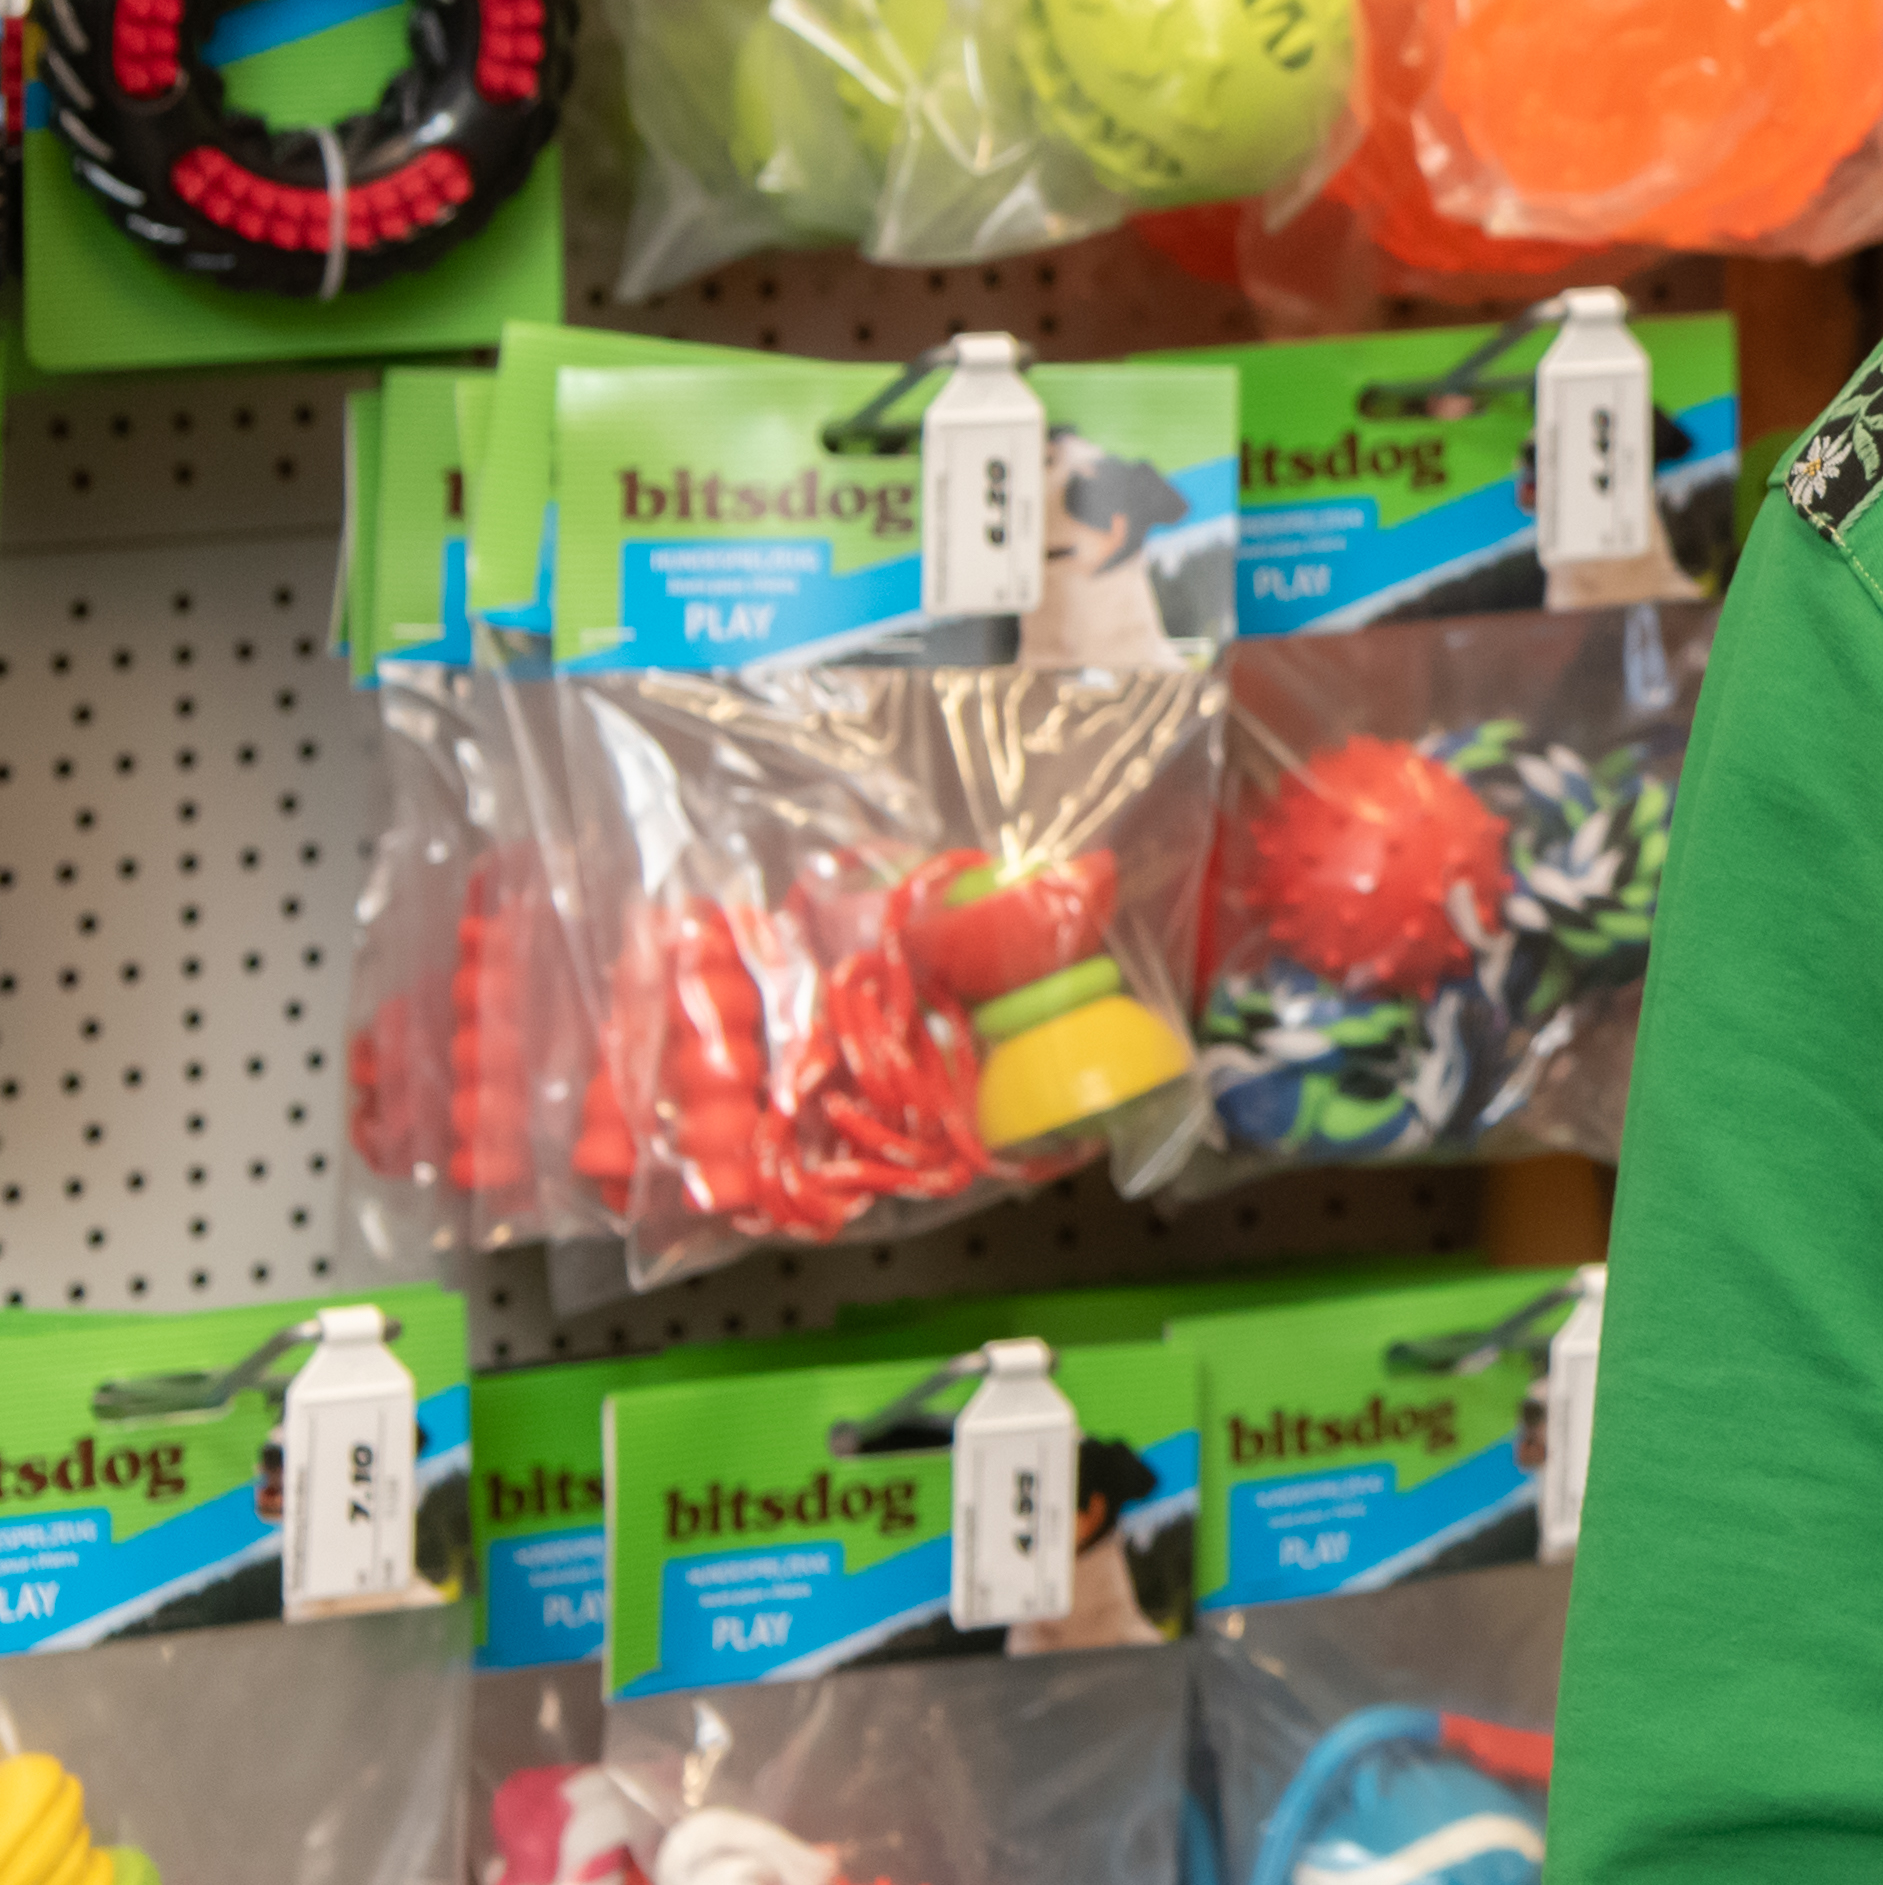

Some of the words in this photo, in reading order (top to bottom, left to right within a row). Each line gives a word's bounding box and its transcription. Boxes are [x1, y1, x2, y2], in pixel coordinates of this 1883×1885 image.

[1240, 429, 1448, 492] itsdog
[620, 468, 915, 539] bitsdog
[1253, 562, 1331, 602] PLAY
[684, 601, 776, 643] PLAY
[1228, 1394, 1457, 1468] bitsdog
[347, 1443, 374, 1524] 7.10
[486, 1464, 604, 1522] bits
[663, 1468, 918, 1544] bitsdog
[0, 1580, 60, 1624] LAY
[543, 1589, 604, 1629] PLA
[711, 1611, 793, 1653] PLAY
